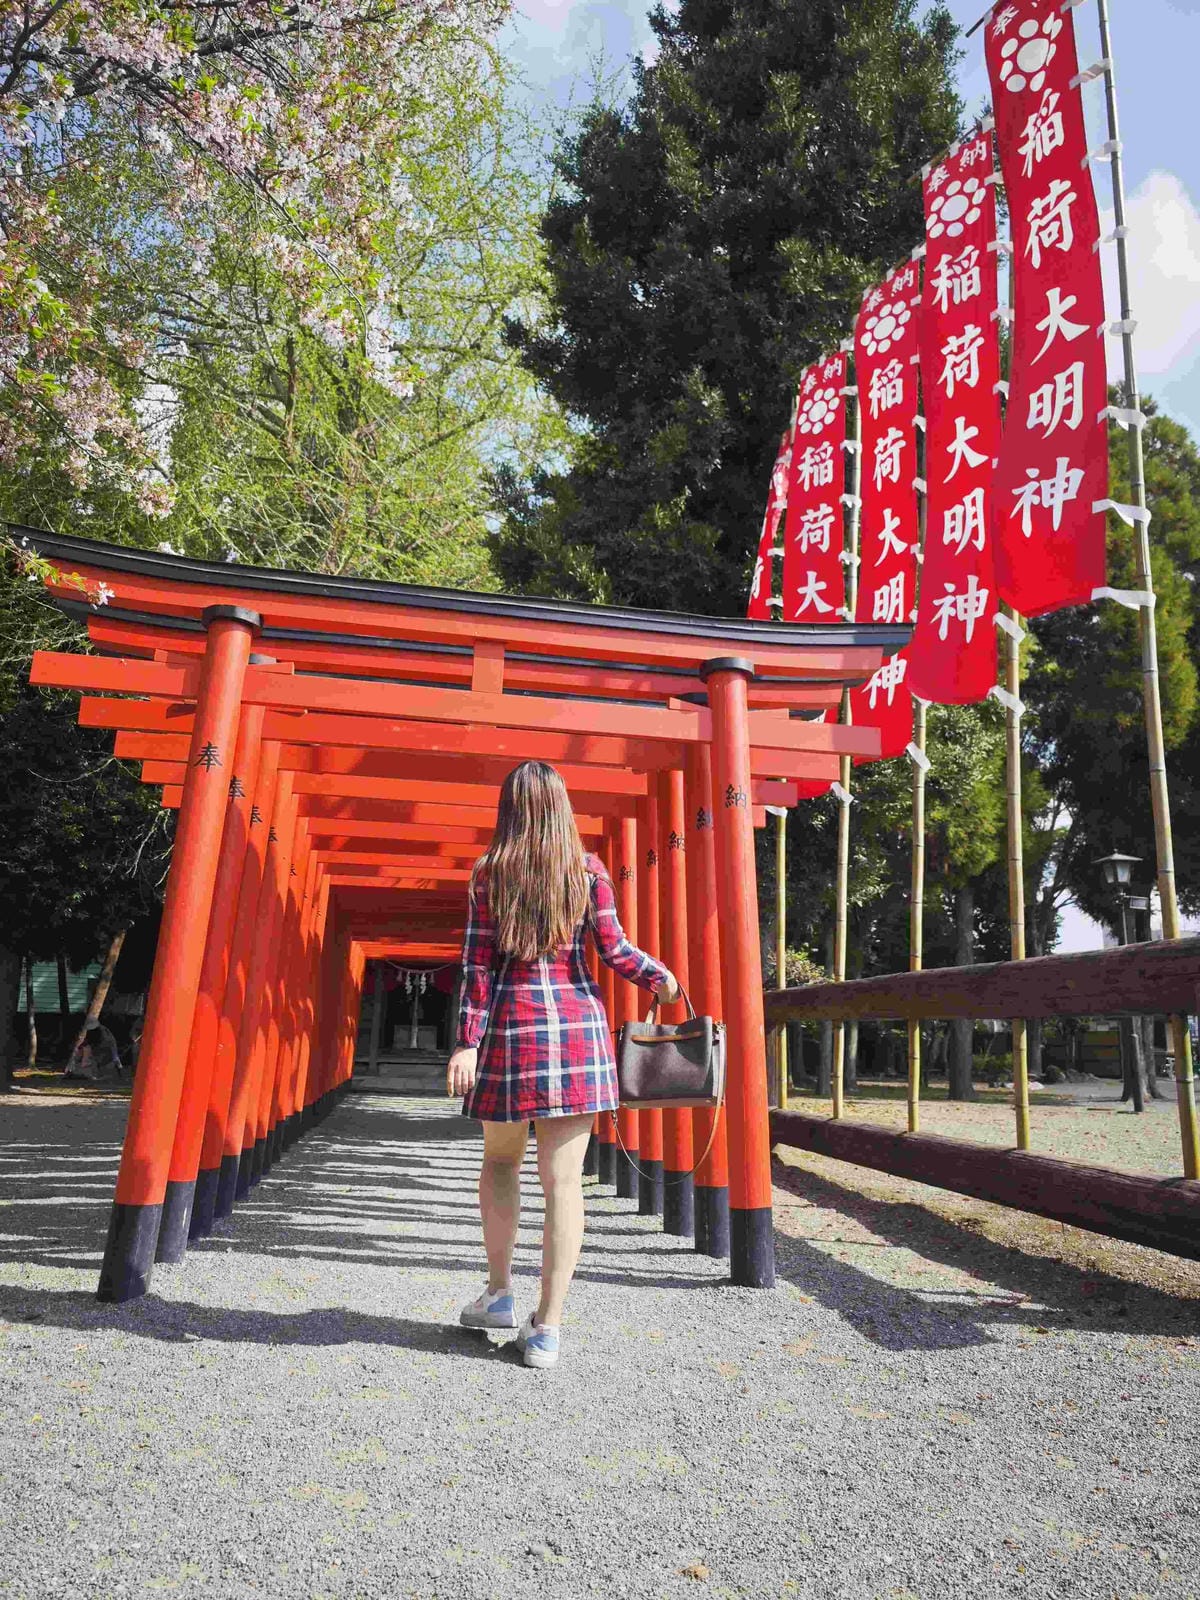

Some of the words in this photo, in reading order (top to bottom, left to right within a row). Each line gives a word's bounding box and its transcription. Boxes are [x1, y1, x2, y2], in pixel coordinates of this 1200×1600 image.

[927, 139, 987, 194] 奉納
[1010, 88, 1090, 538] 稲荷大明神
[930, 244, 989, 643] 稲荷大明神
[194, 741, 222, 772] 奉
[725, 784, 746, 809] 納
